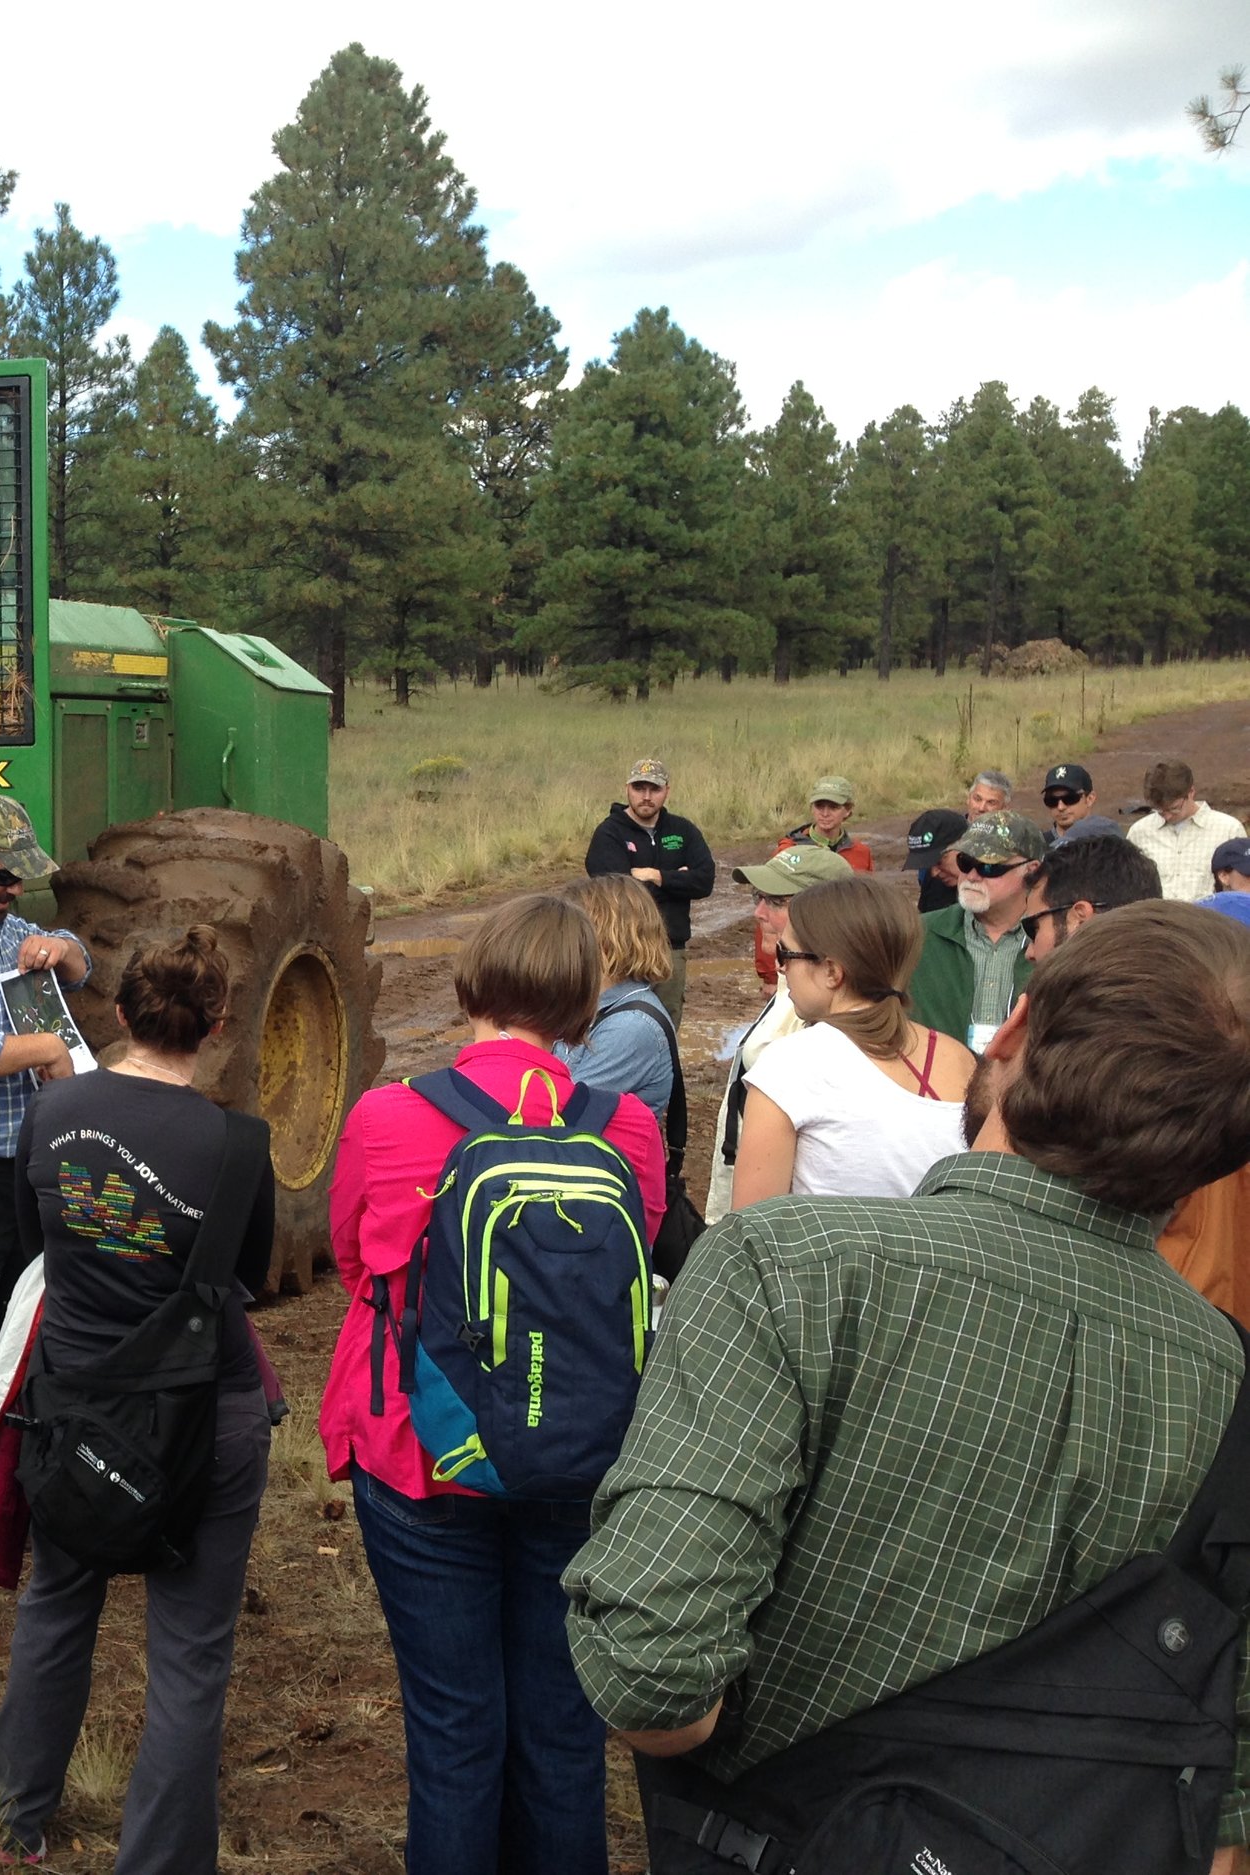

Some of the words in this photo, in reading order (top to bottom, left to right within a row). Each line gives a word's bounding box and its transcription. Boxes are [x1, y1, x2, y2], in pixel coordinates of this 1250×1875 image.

[49, 1130, 77, 1151] WHAT
[80, 1129, 117, 1148] BRINGS
[116, 1144, 136, 1164] YOU
[134, 1161, 159, 1184] JOY
[154, 1182, 168, 1196] IN
[164, 1192, 204, 1220] NATURE?
[527, 1331, 545, 1427] patagonia
[922, 1846, 935, 1863] The
[932, 1858, 952, 1875] Na
